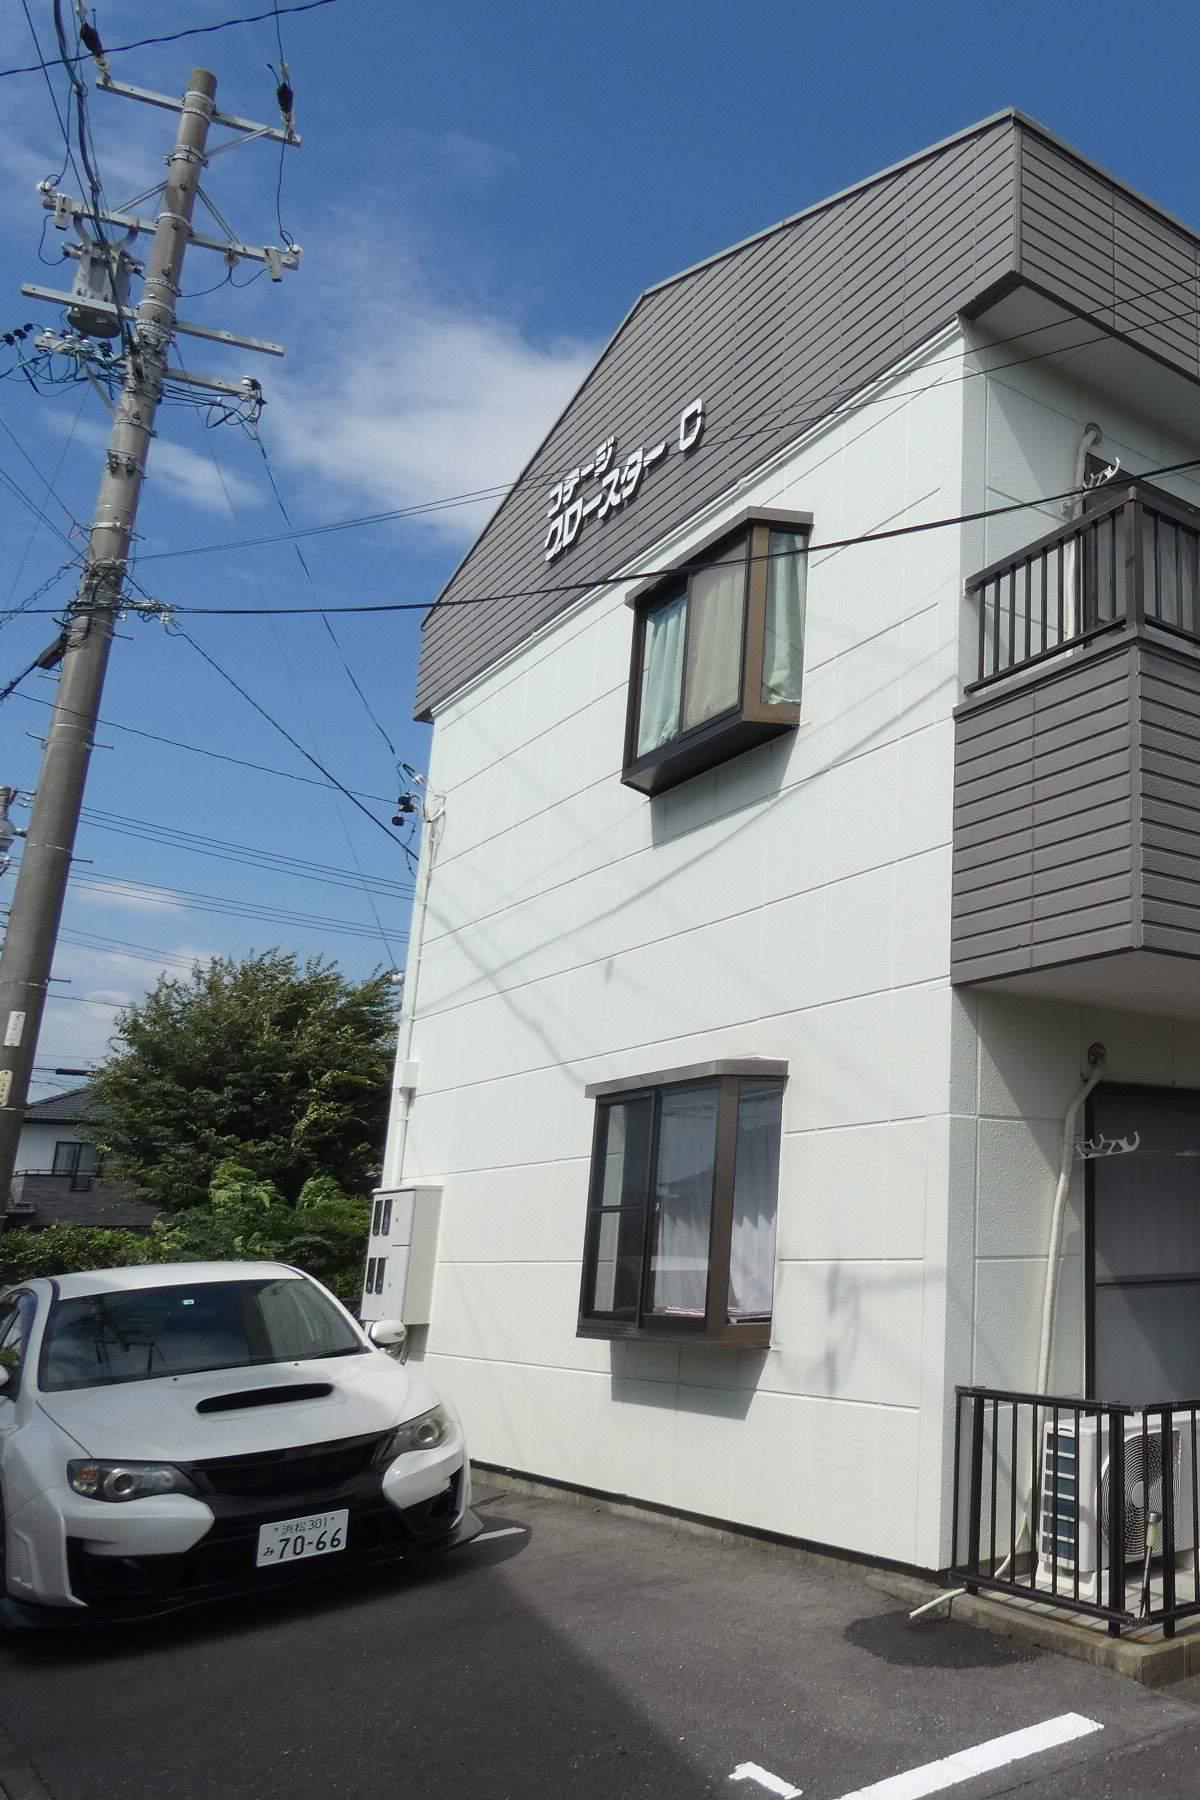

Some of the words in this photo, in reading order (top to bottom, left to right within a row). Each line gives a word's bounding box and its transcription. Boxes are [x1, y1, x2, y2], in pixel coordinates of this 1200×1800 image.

[547, 435, 616, 517] コテージ
[308, 1517, 328, 1531] 301
[279, 1527, 342, 1560] 70-66
